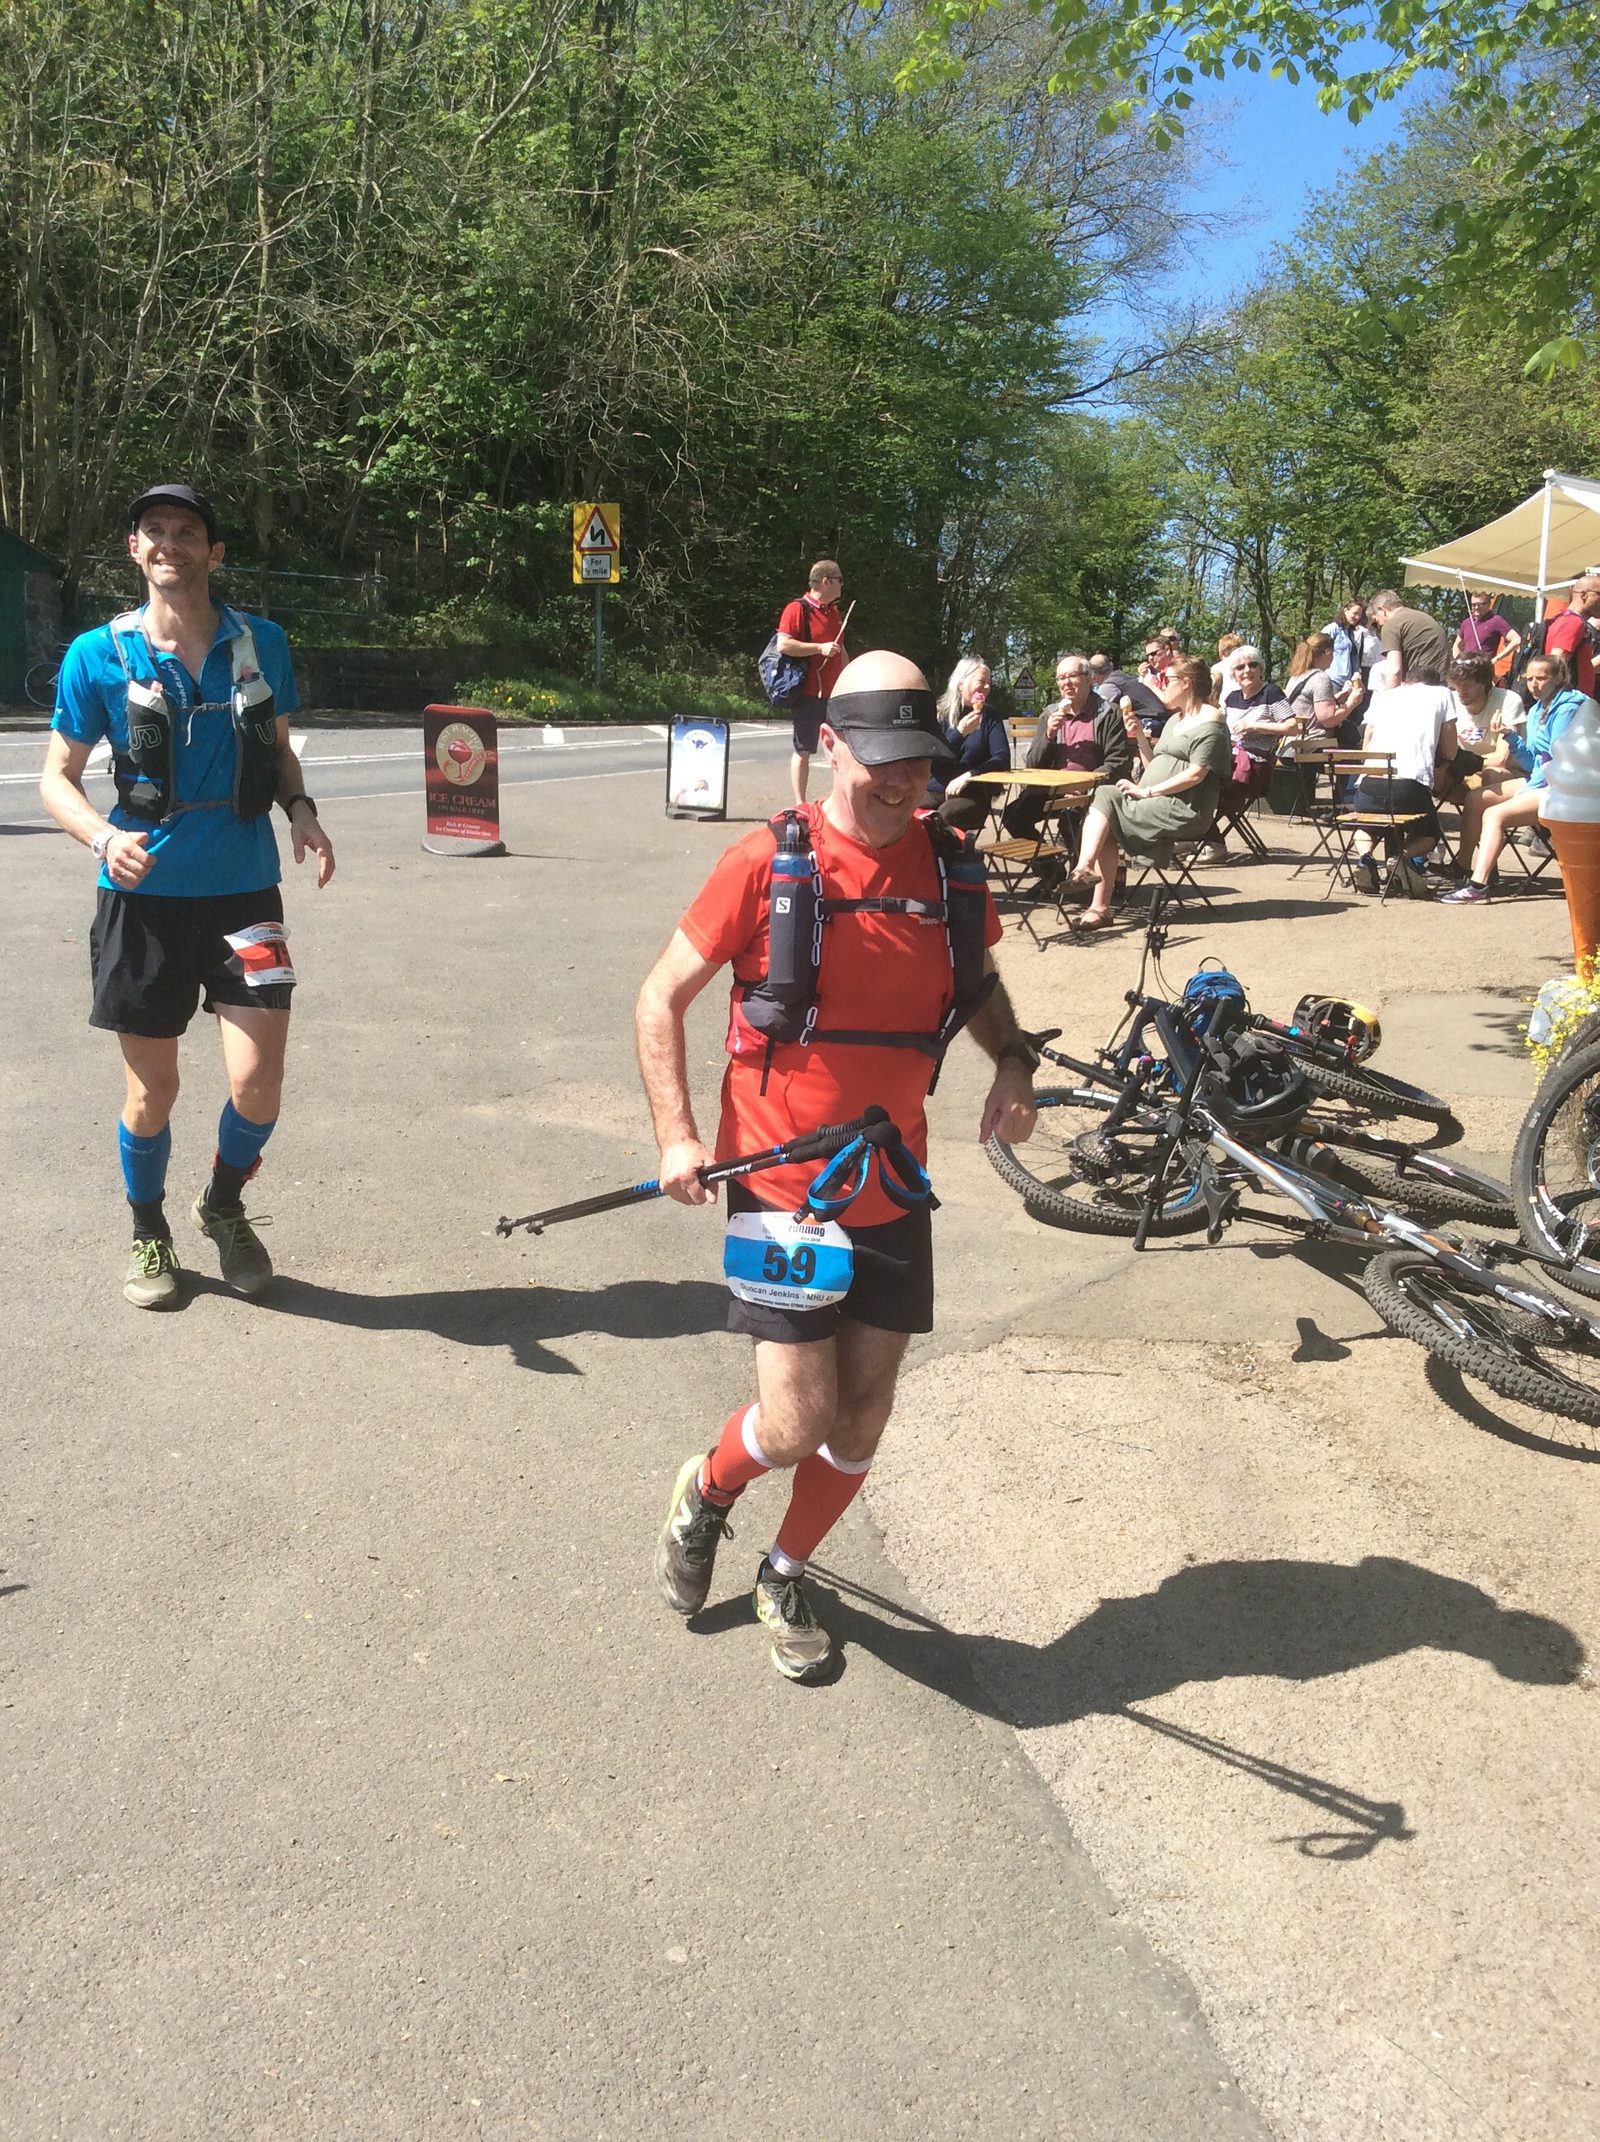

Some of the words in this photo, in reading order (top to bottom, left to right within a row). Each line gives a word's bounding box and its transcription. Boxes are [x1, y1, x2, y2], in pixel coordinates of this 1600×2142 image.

[592, 567, 607, 575] mile
[429, 792, 448, 803] ICE
[453, 795, 496, 808] CREAM
[788, 1225, 825, 1237] running
[763, 1245, 816, 1285] 59
[769, 1289, 799, 1299] Jenkins
